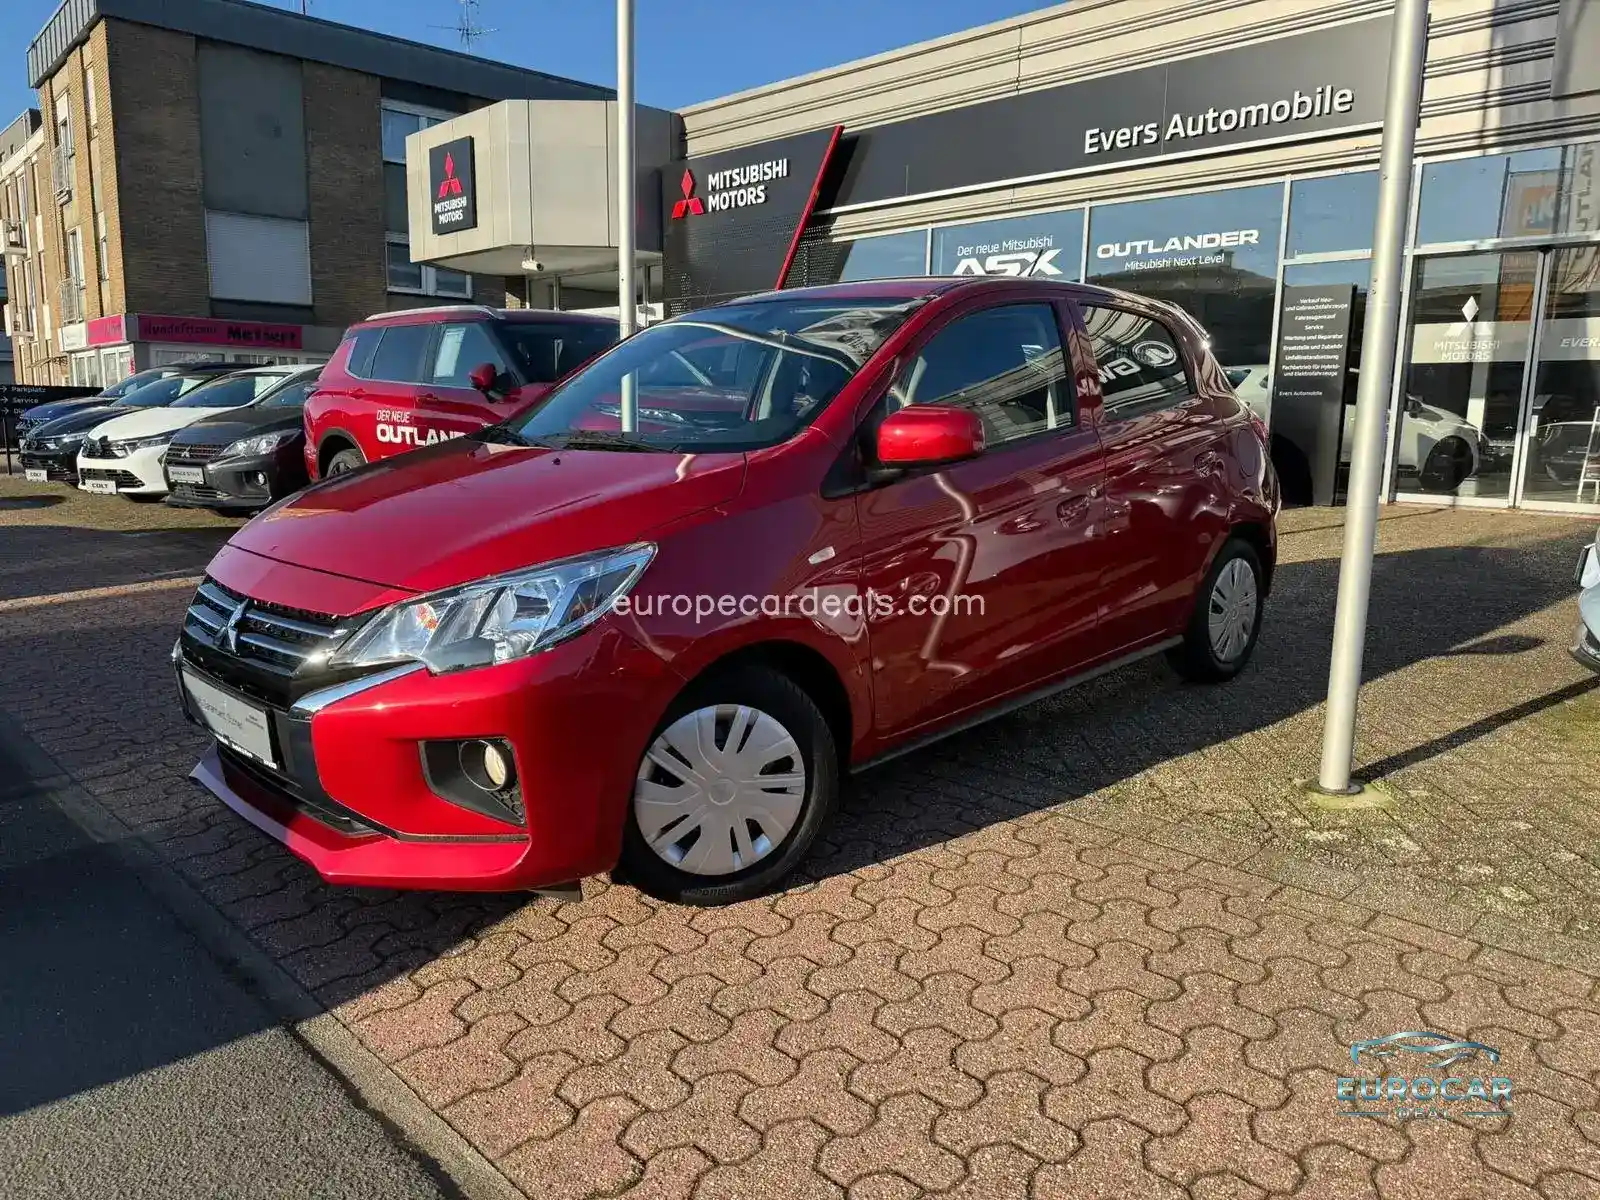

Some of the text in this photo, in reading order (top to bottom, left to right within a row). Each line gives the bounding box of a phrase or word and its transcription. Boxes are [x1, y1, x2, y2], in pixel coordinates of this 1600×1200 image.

[1084, 84, 1354, 154] Evers Automobile
[707, 158, 788, 191] MITSUBISHI
[434, 195, 467, 214] MITSUBISHI
[707, 185, 766, 212] MOTORS
[438, 209, 463, 225] MOTORS
[957, 235, 1054, 257] Der neue Mitsubishi
[1096, 229, 1259, 259] OUTLANDER
[952, 248, 1064, 276] ASX
[1124, 253, 1225, 271] Mitsubishi Next Level
[1433, 340, 1501, 350] MITSUBISHI
[1560, 336, 1600, 348] EVER
[1440, 351, 1491, 361] MOTORS
[11, 386, 46, 394] Parkplatz
[376, 409, 411, 424] DER NEUE
[376, 423, 467, 446] OUTLAN
